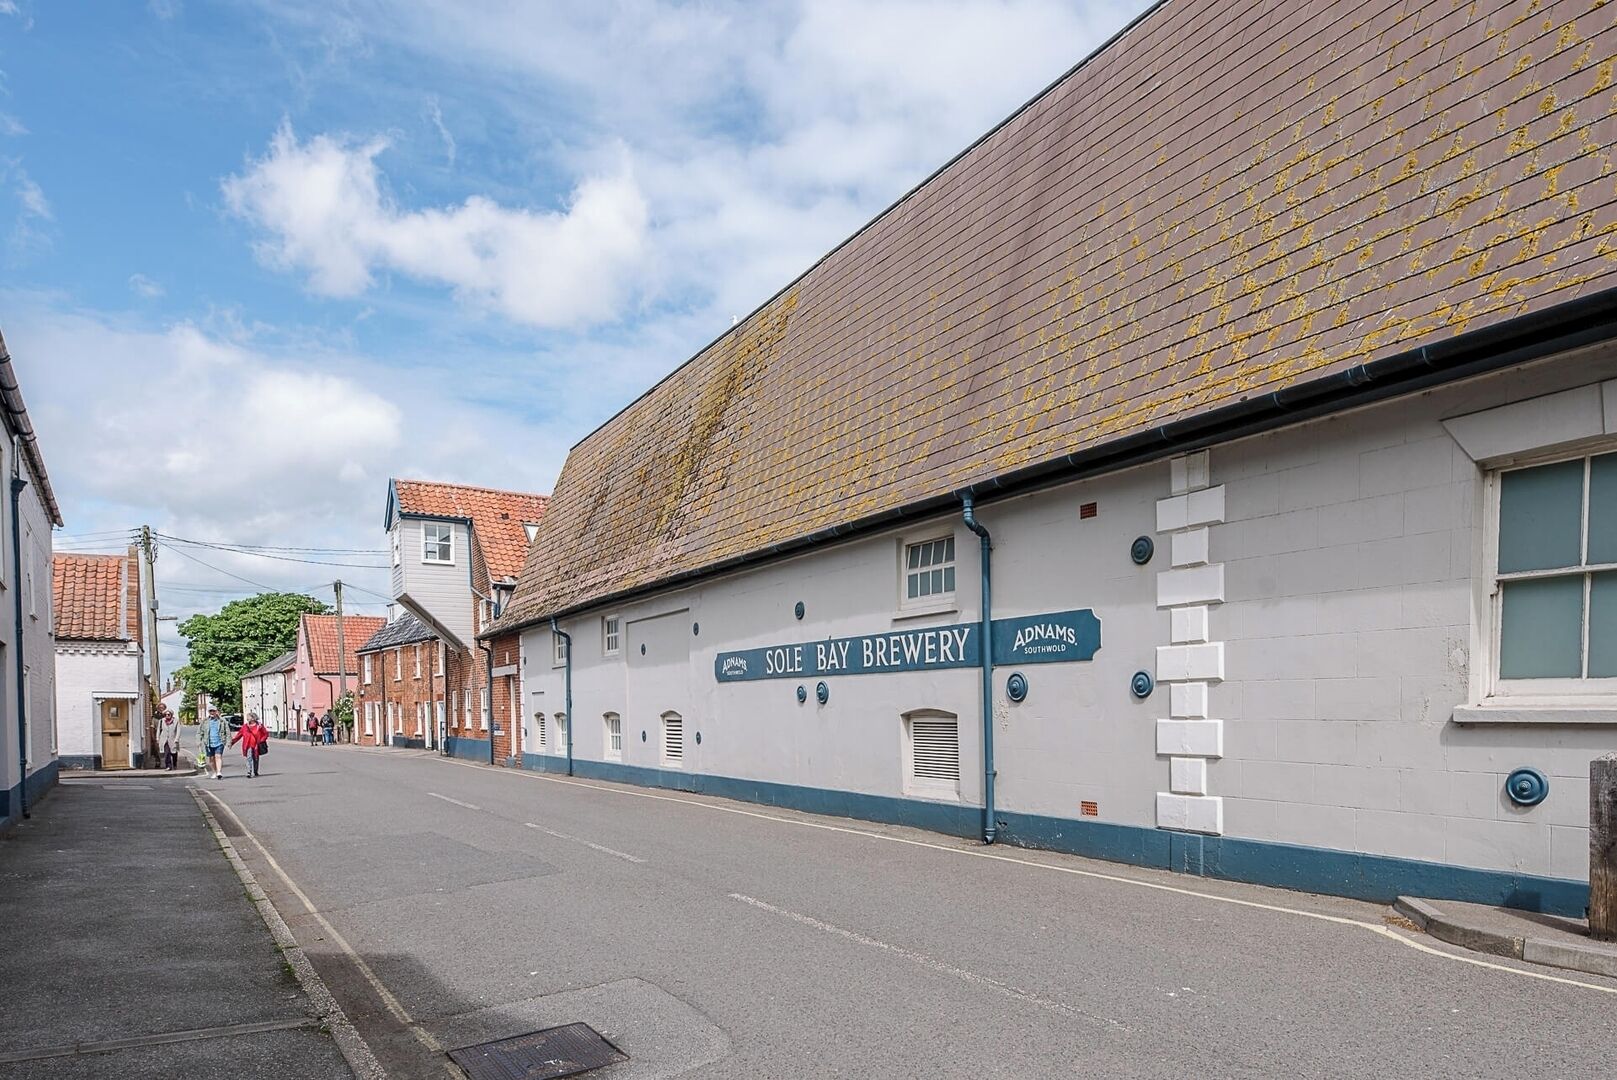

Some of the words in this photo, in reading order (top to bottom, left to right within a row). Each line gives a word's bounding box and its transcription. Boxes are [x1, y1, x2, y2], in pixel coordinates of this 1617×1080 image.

[766, 647, 803, 674] SOLE
[817, 641, 850, 671] BAY
[862, 628, 970, 668] BREWERY
[1024, 645, 1066, 654] SOUTHWOLD
